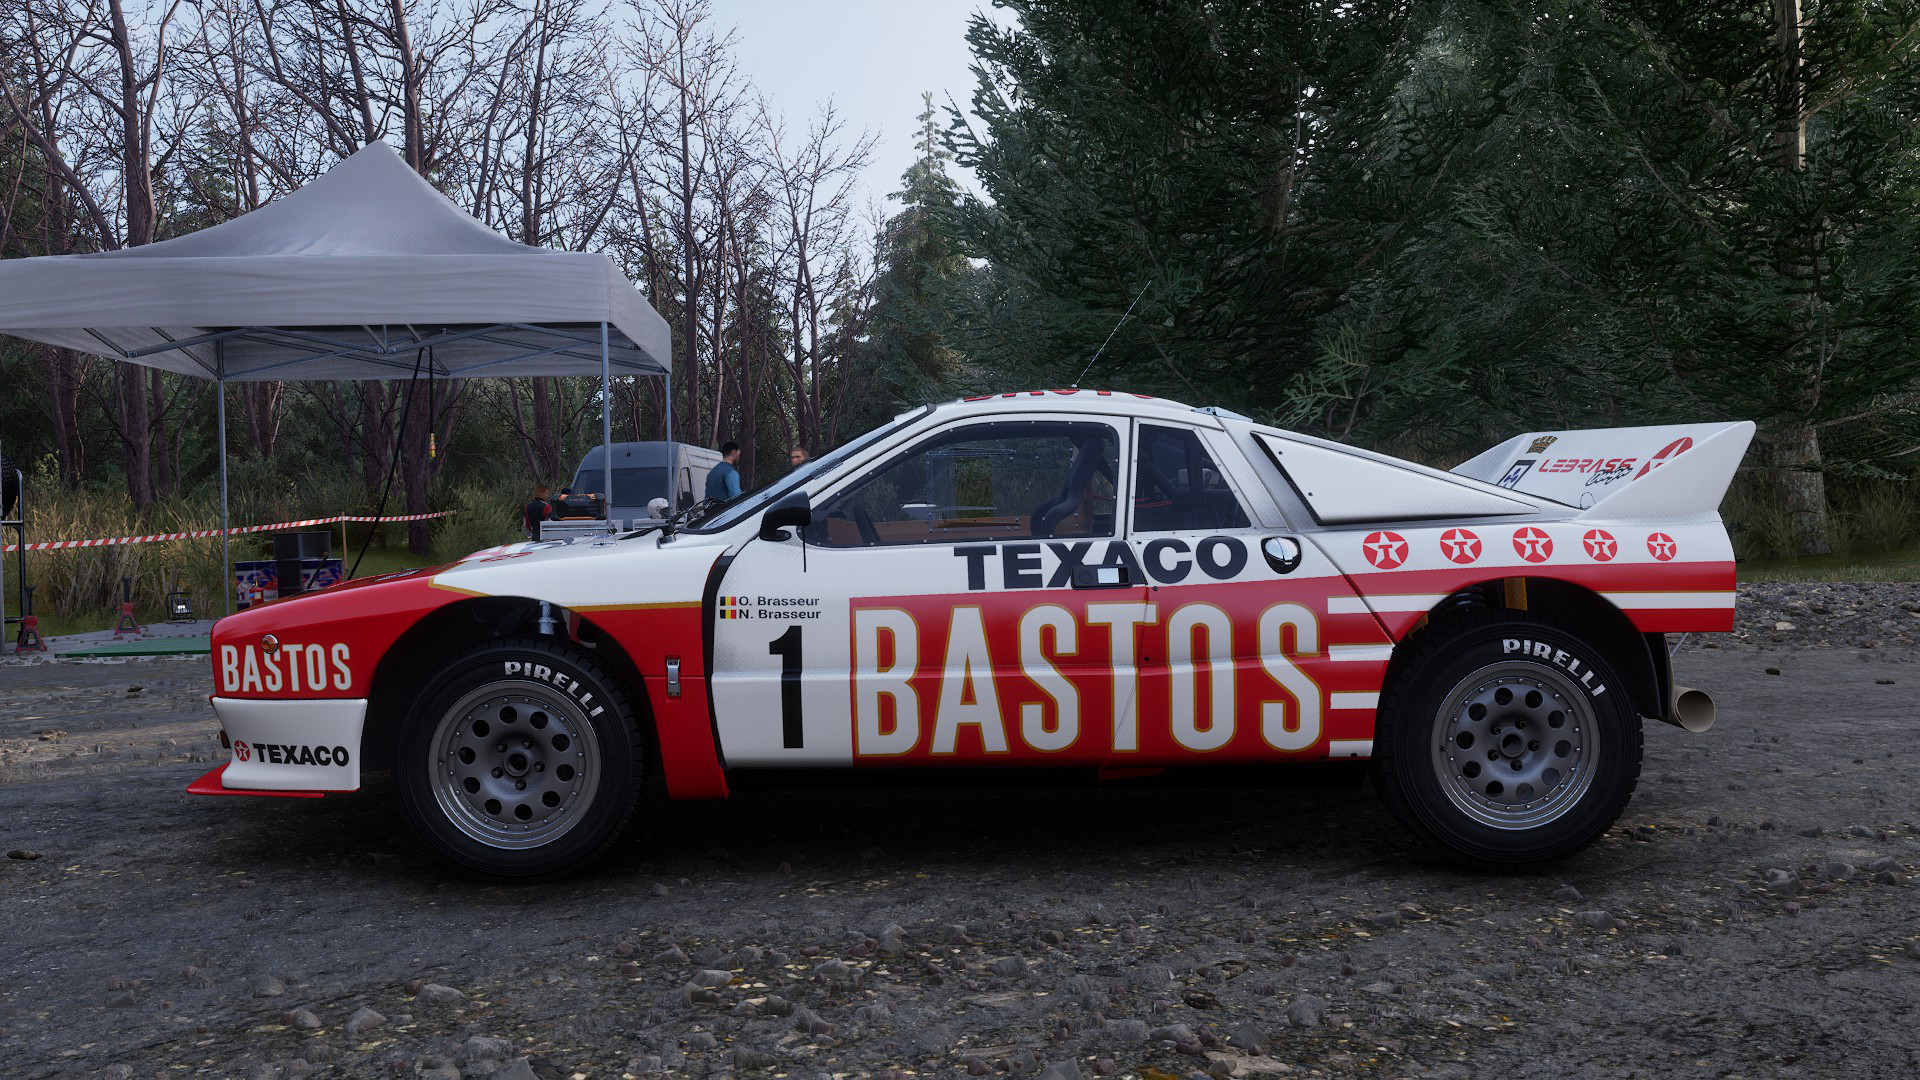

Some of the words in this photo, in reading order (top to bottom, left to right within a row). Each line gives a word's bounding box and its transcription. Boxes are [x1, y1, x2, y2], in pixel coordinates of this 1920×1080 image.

[954, 536, 1248, 590] TEXACO
[739, 596, 752, 606] O.
[758, 596, 819, 606] Brasseur
[739, 609, 754, 619] N.
[758, 609, 821, 619] Brasseur
[221, 643, 352, 692] BASTOS
[504, 661, 605, 718] PIRELLI
[769, 625, 804, 749] 1
[855, 602, 1324, 756] BASTOS
[1503, 638, 1607, 697] PIRELLI
[252, 743, 349, 767] TEXACO
